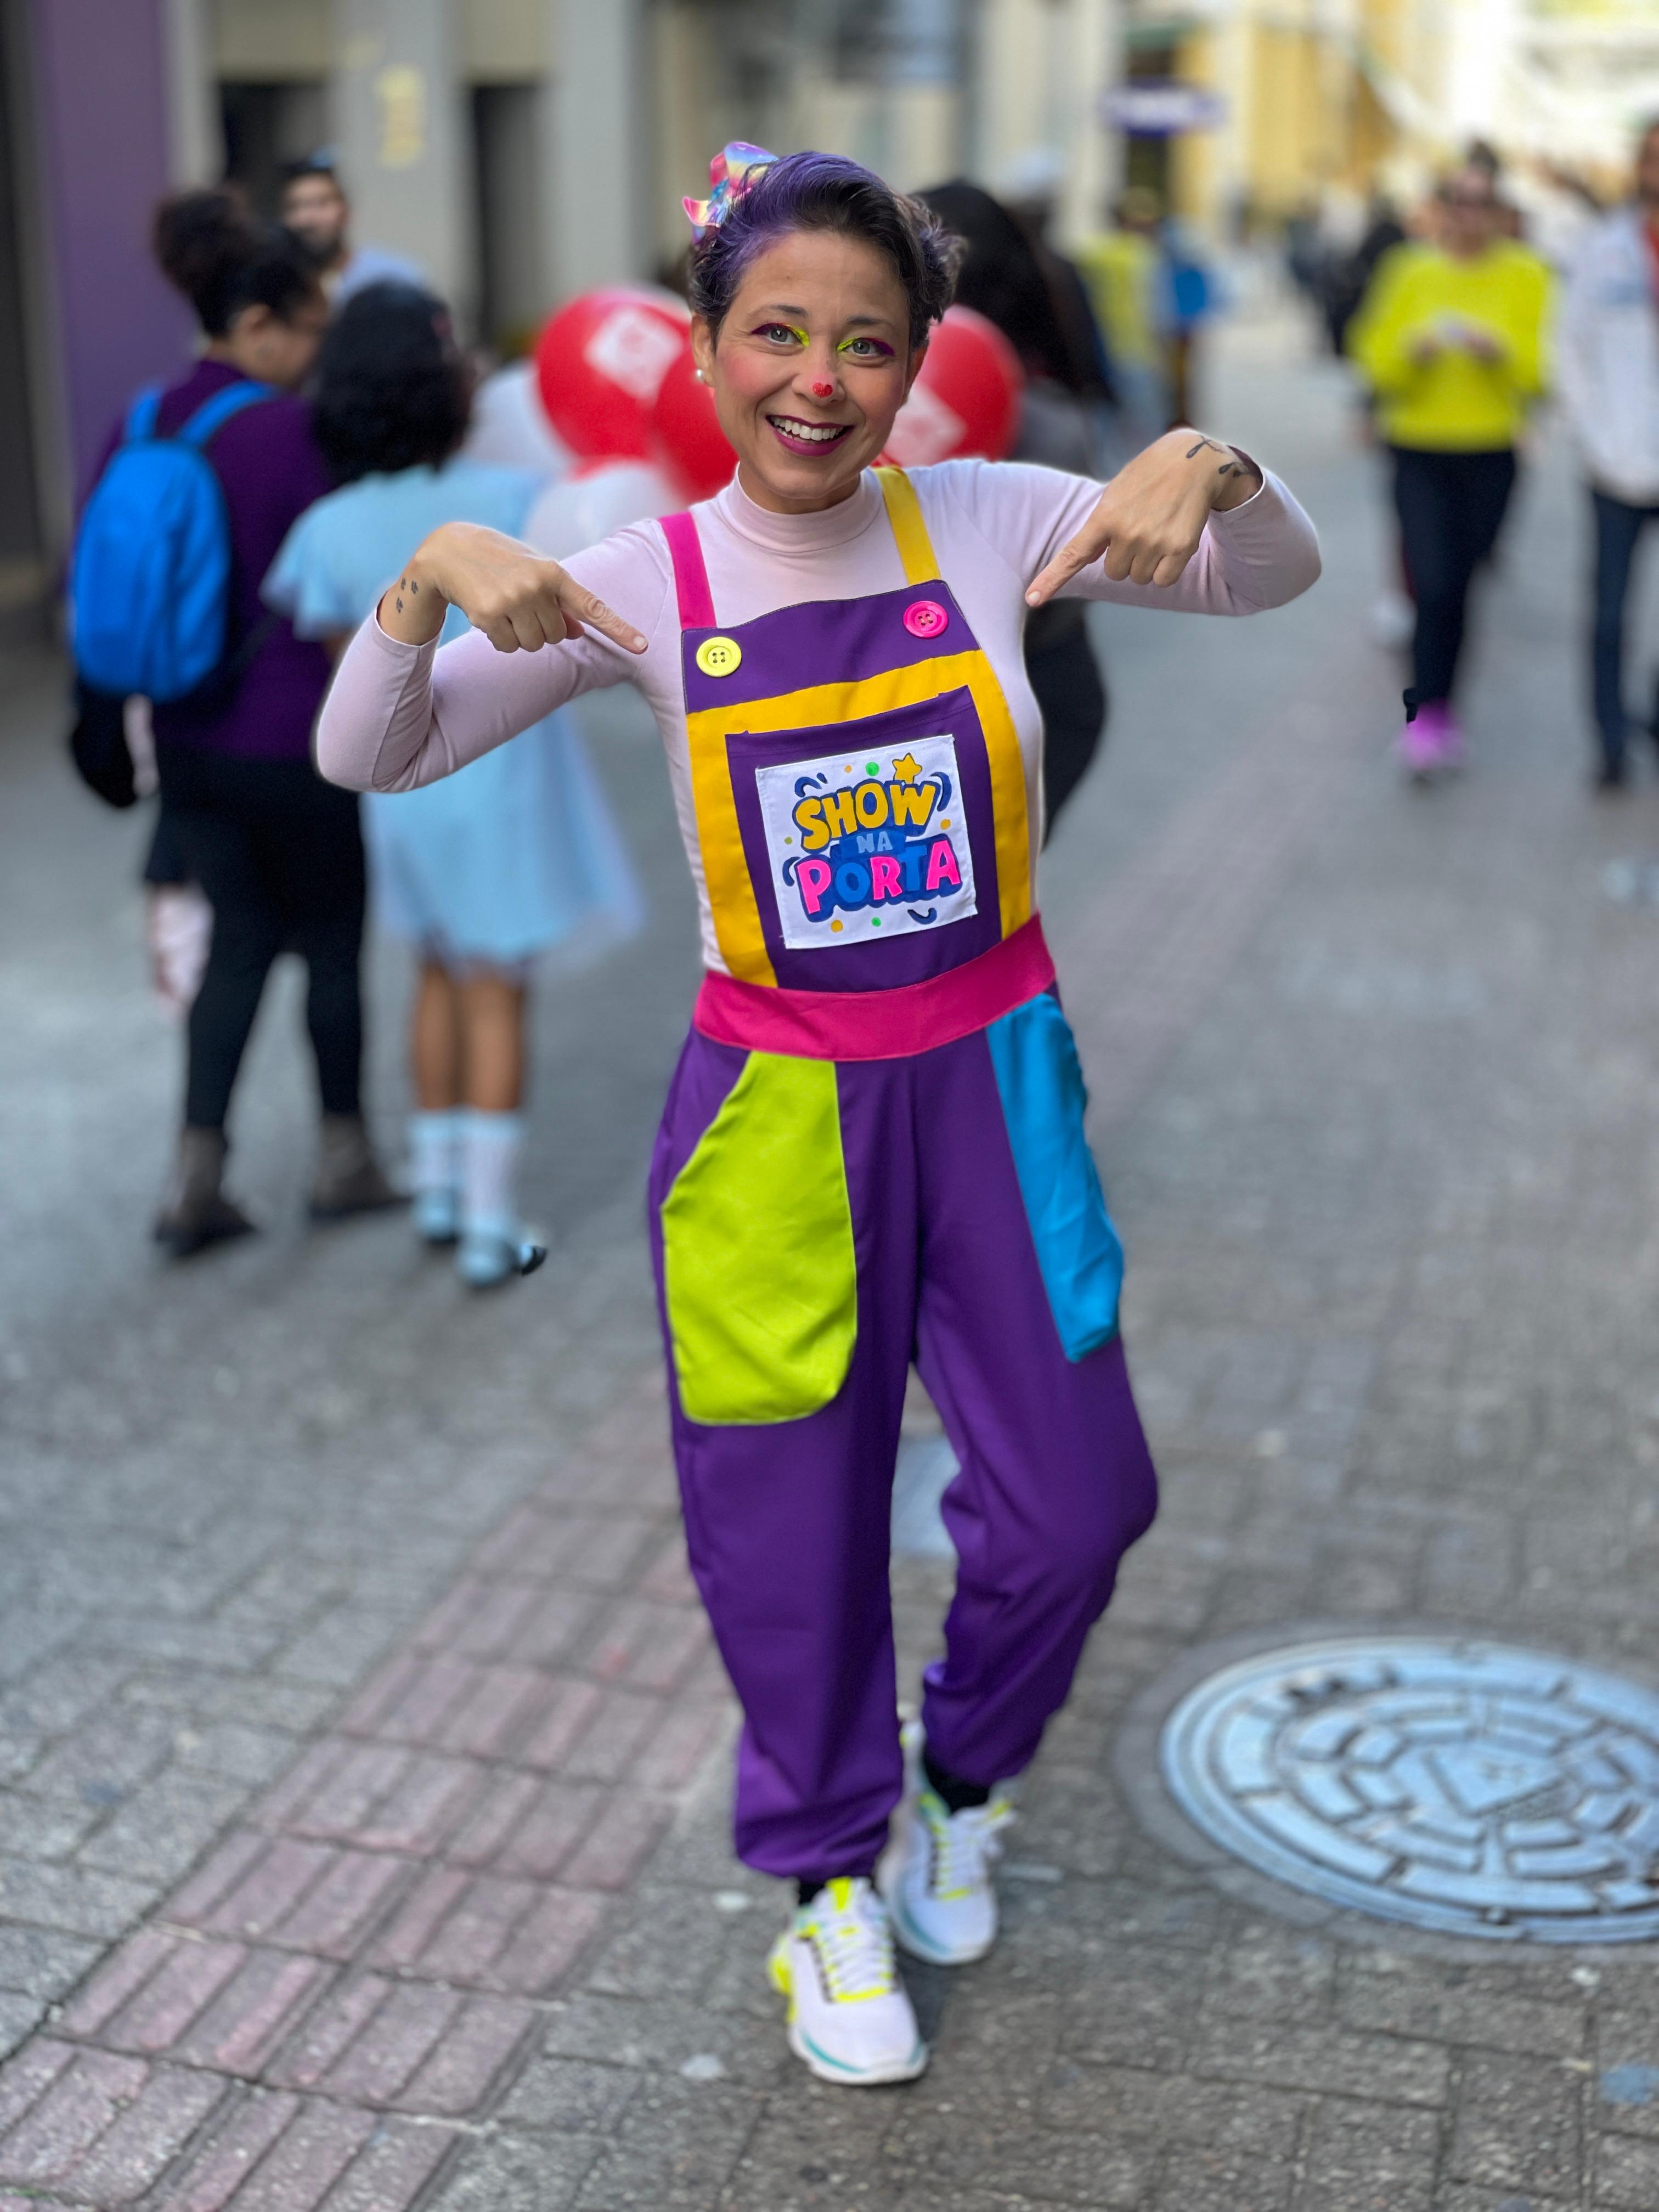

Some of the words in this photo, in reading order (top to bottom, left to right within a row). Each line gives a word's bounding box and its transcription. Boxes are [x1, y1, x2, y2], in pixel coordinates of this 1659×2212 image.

[794, 782, 937, 850] SHOW
[856, 830, 894, 854] NA
[796, 839, 961, 915] PORTA
